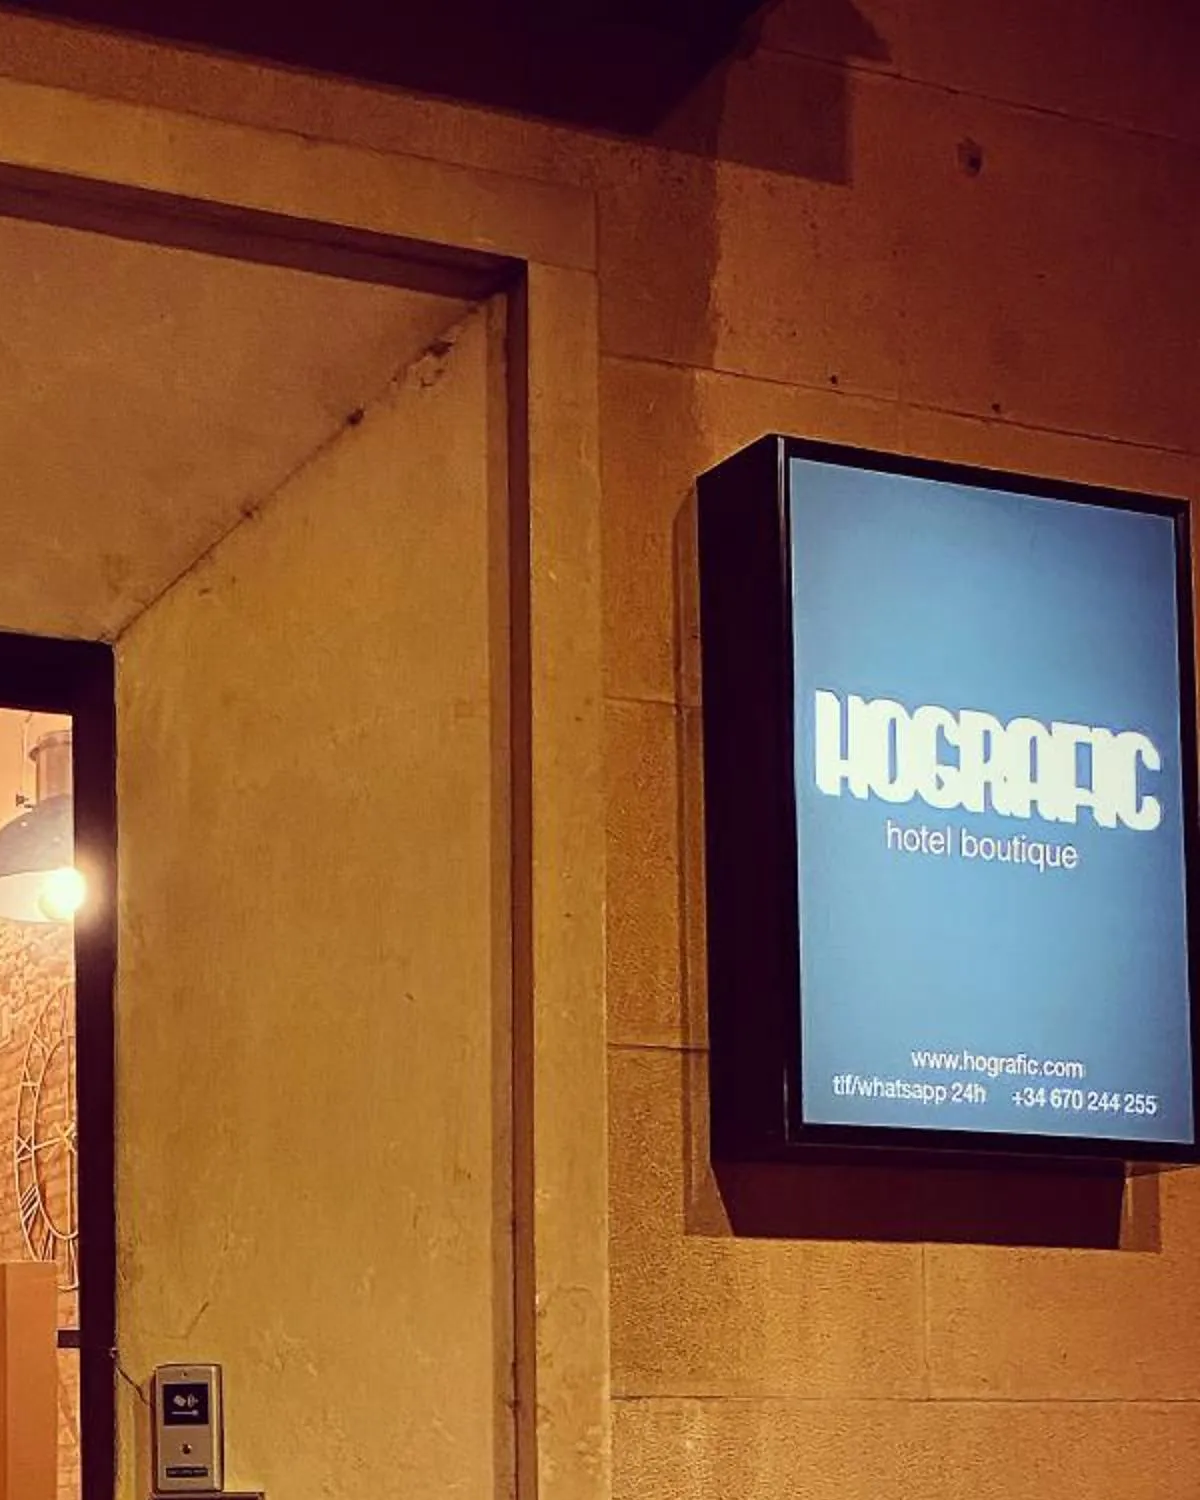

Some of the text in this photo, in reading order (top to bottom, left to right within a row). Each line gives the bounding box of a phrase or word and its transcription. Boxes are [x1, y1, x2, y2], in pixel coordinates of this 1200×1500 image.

[814, 690, 1162, 831] HOGRAFIC
[886, 819, 1079, 873] hotel boutique
[911, 1049, 1086, 1079] www.hografic.com
[950, 1084, 987, 1105] 24h
[1011, 1087, 1046, 1109] +34
[1050, 1088, 1083, 1110] 670
[1087, 1090, 1121, 1112] 244
[1123, 1093, 1158, 1115] 255
